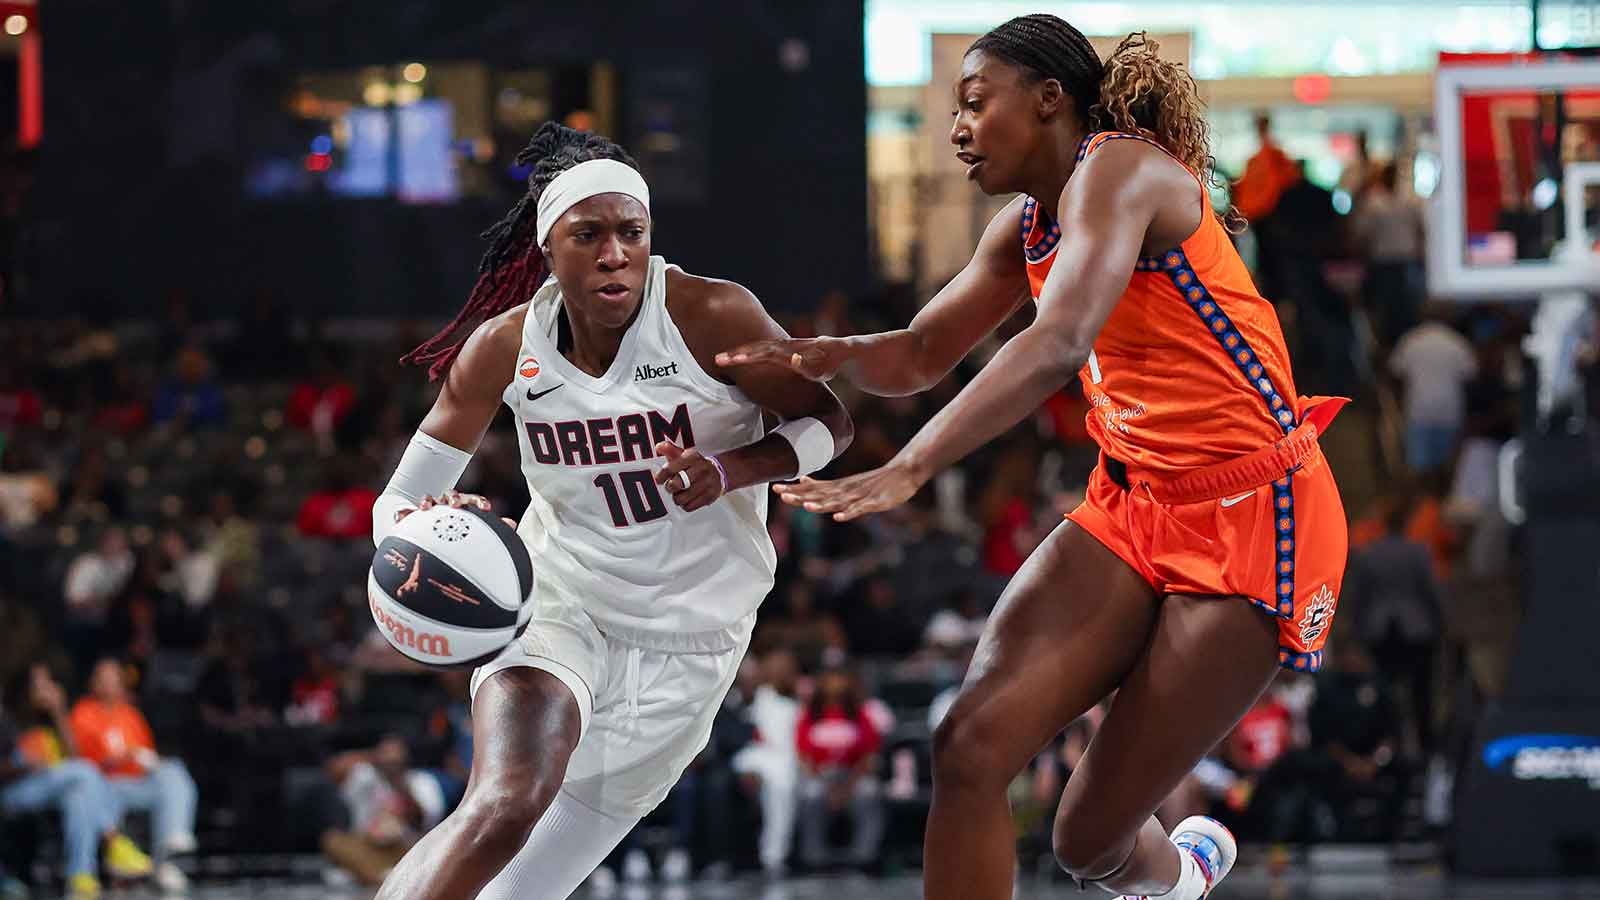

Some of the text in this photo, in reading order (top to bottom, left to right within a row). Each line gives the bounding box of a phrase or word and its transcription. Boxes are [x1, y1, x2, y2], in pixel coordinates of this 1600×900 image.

[633, 361, 678, 381] Albert
[524, 403, 696, 466] DREAM
[592, 469, 669, 528] 10
